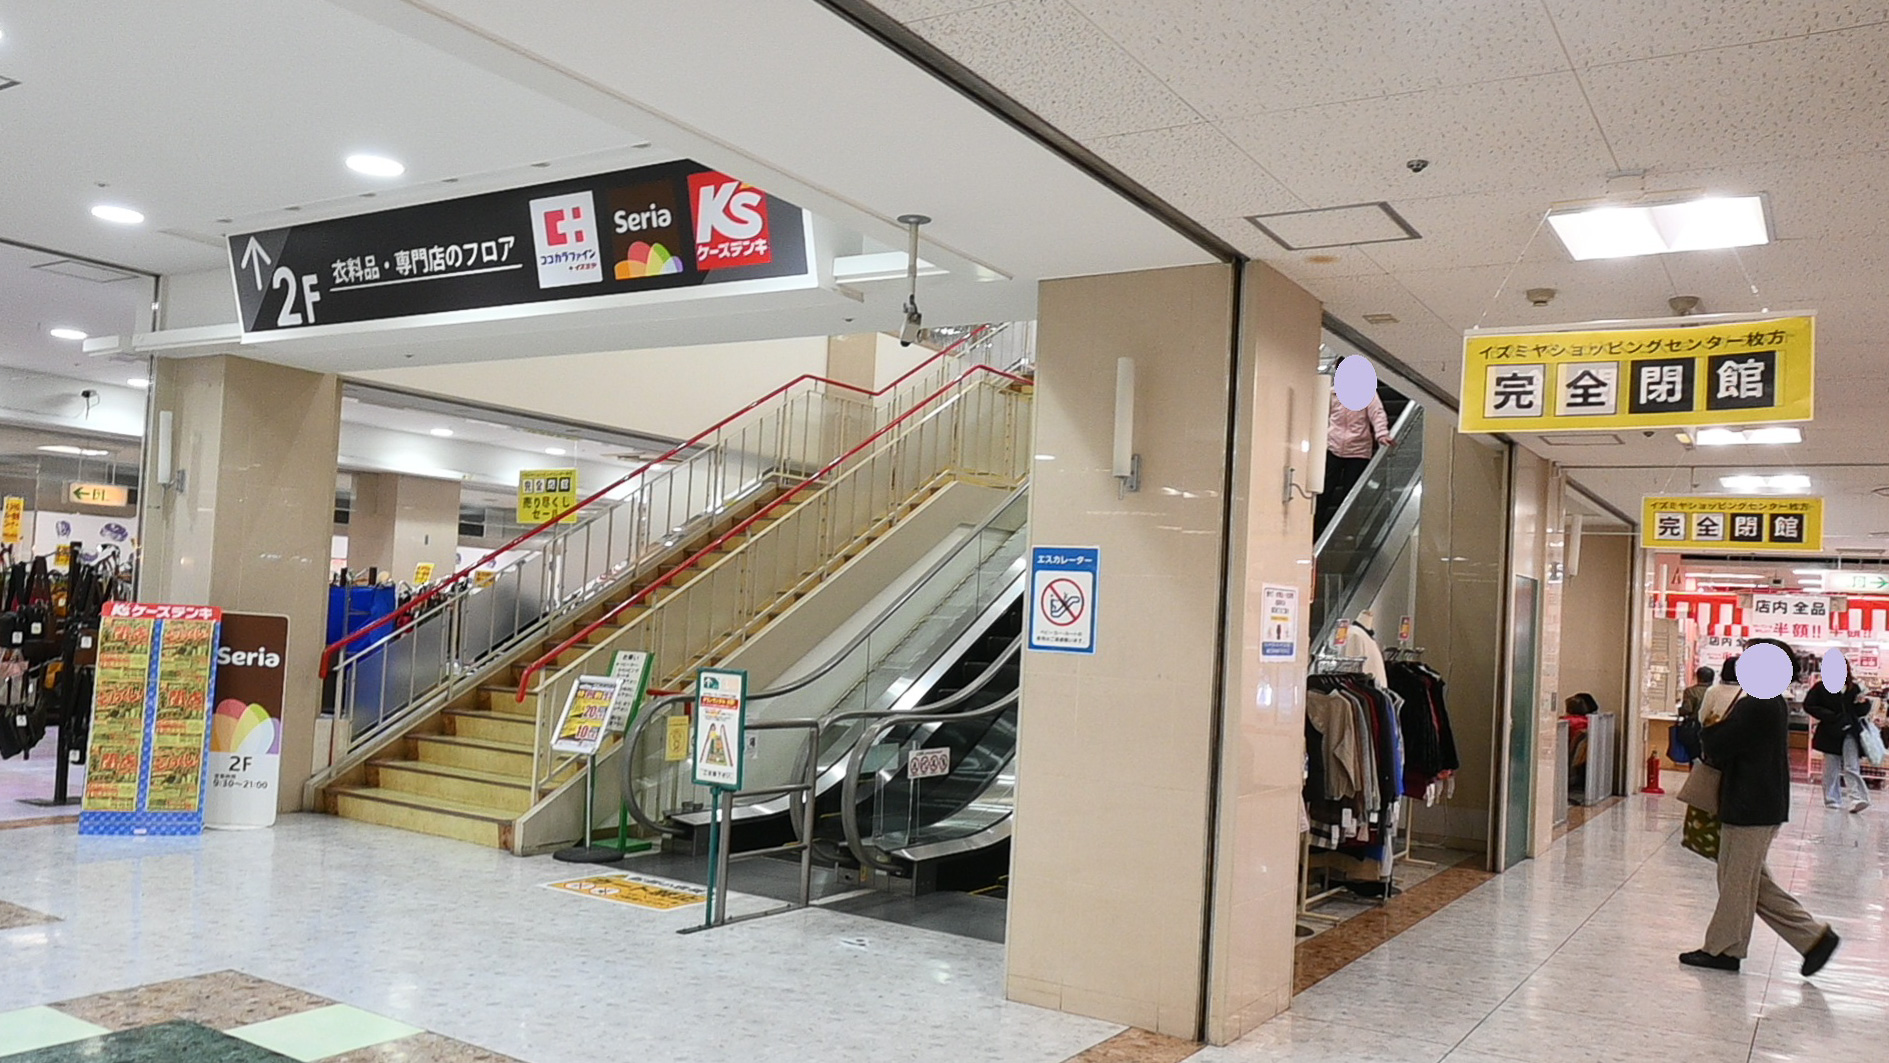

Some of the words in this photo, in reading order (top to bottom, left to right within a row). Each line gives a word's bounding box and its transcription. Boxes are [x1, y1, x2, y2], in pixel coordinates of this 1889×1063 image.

[614, 203, 672, 234] Seria
[331, 236, 515, 284] 衣料品・専門店のフロア
[540, 249, 596, 265] ココカラファイン
[272, 265, 321, 327] 2F
[1479, 330, 1786, 360] イズミヤショッピングセンター枚方
[1493, 358, 1766, 410] 完全閉館
[1658, 516, 1799, 538] 完全閉館
[1037, 554, 1093, 565] エスカレーター
[217, 646, 281, 668] Seria
[229, 755, 252, 771] 2F
